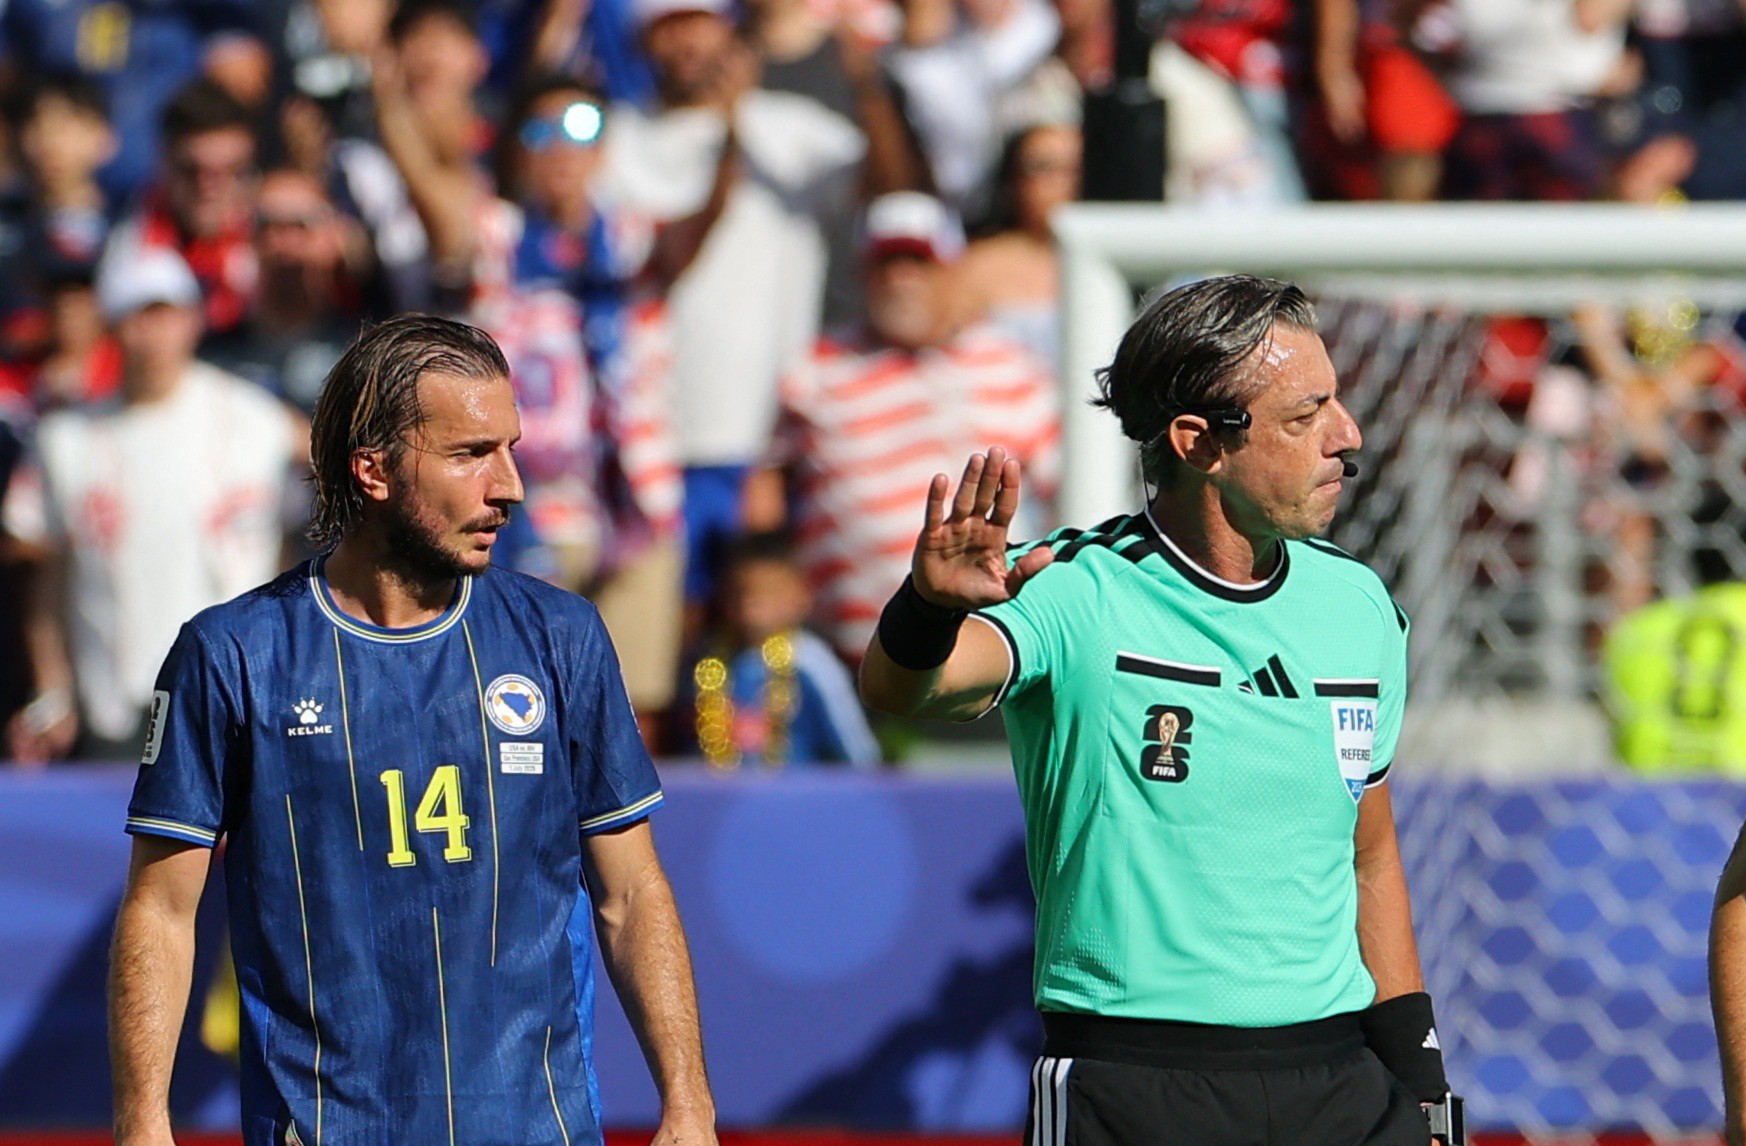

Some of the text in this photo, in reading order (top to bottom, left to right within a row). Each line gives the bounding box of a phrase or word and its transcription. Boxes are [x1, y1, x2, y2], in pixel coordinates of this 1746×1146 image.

[1337, 708, 1374, 732] FIFA
[287, 724, 333, 737] KELME
[1151, 765, 1177, 778] FIFA
[380, 764, 472, 868] 14
